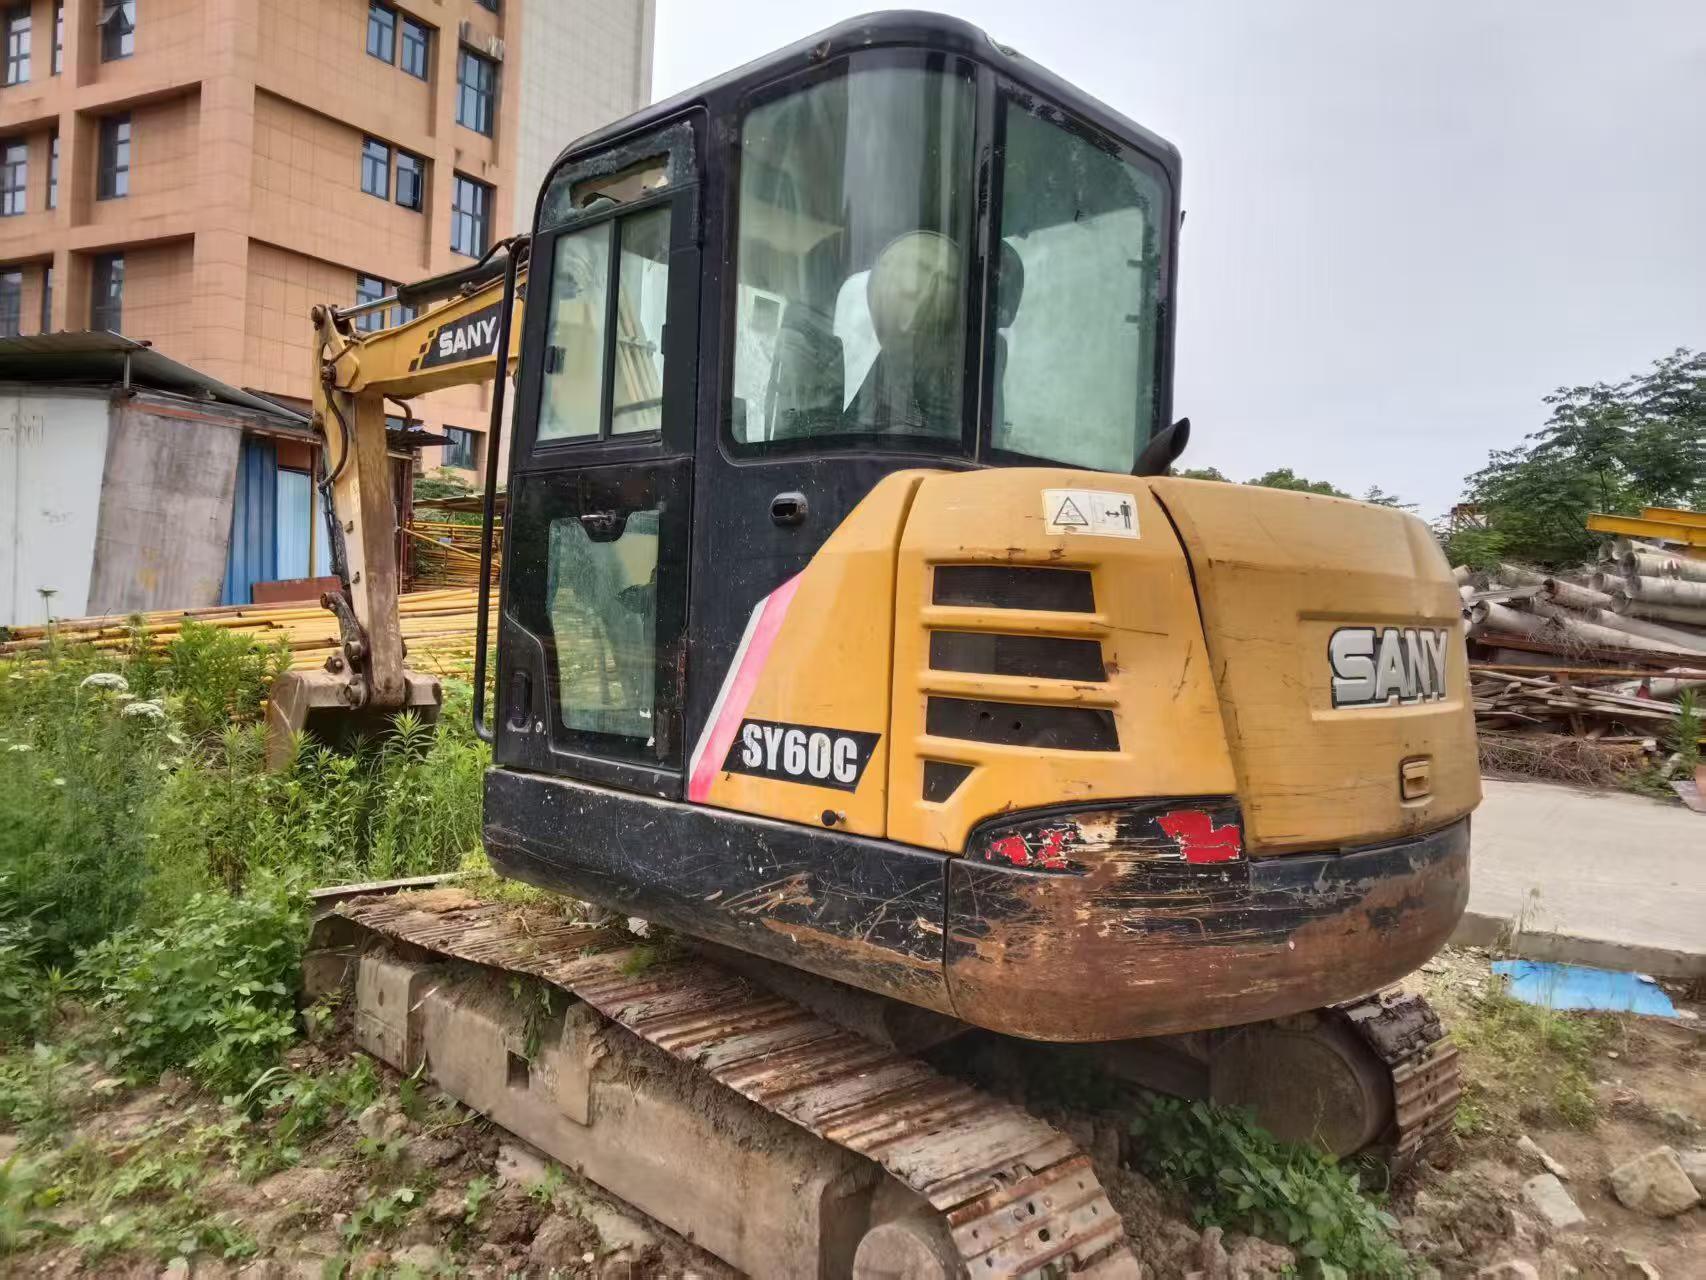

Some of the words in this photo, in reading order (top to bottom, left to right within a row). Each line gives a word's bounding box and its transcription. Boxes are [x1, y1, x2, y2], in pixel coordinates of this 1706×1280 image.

[439, 316, 496, 357] SANY
[1329, 627, 1448, 708] SANY
[742, 723, 858, 783] SY60C
